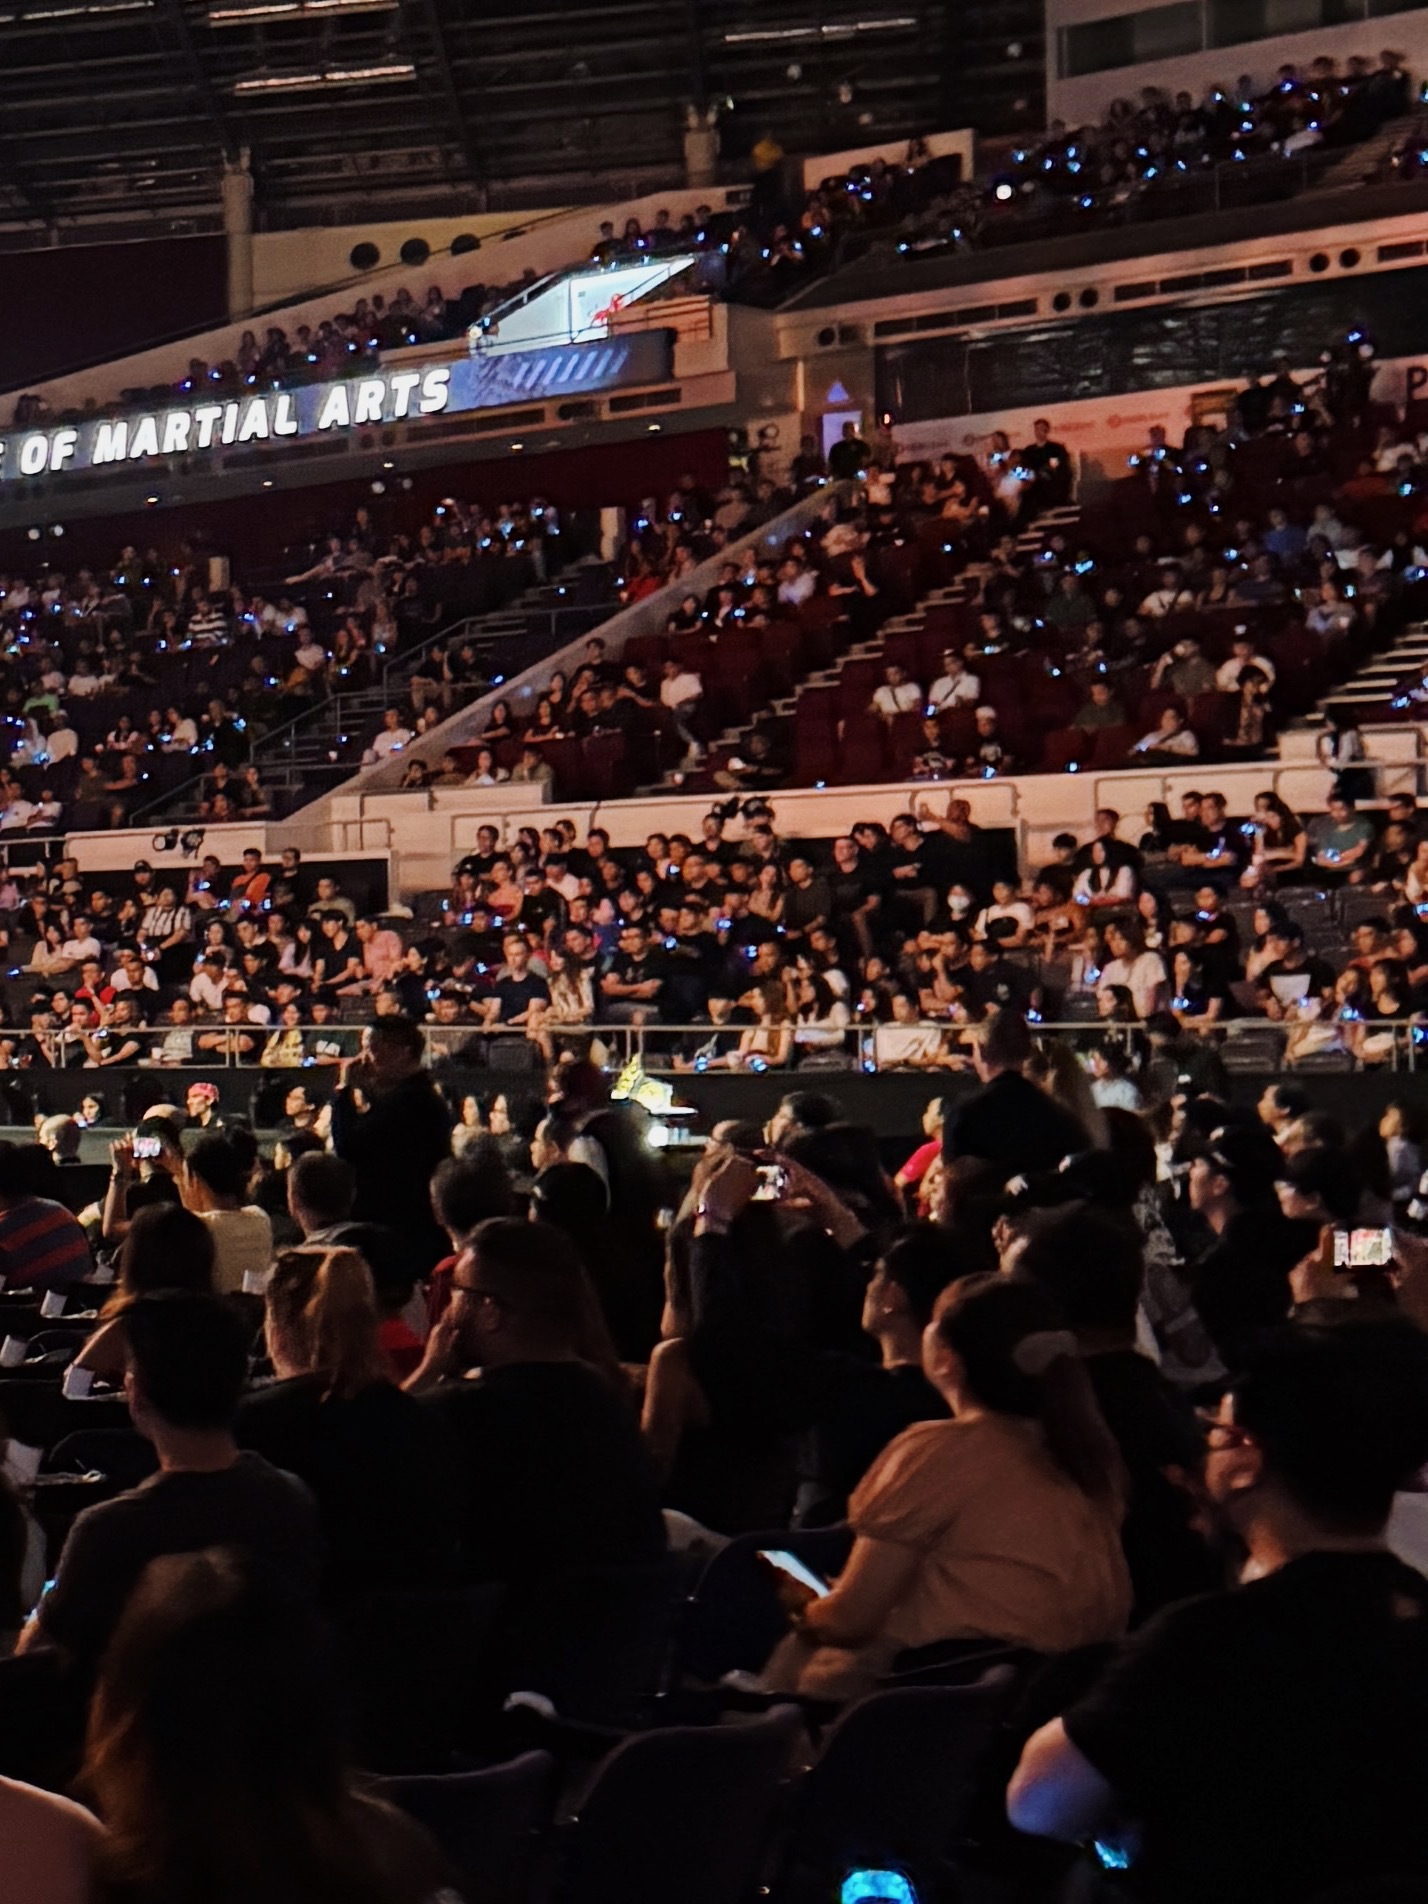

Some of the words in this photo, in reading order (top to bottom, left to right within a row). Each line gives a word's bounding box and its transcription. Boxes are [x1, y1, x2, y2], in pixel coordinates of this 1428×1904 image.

[20, 430, 78, 475] OF
[92, 394, 298, 465] MARTIAL
[318, 368, 451, 429] ARTS
